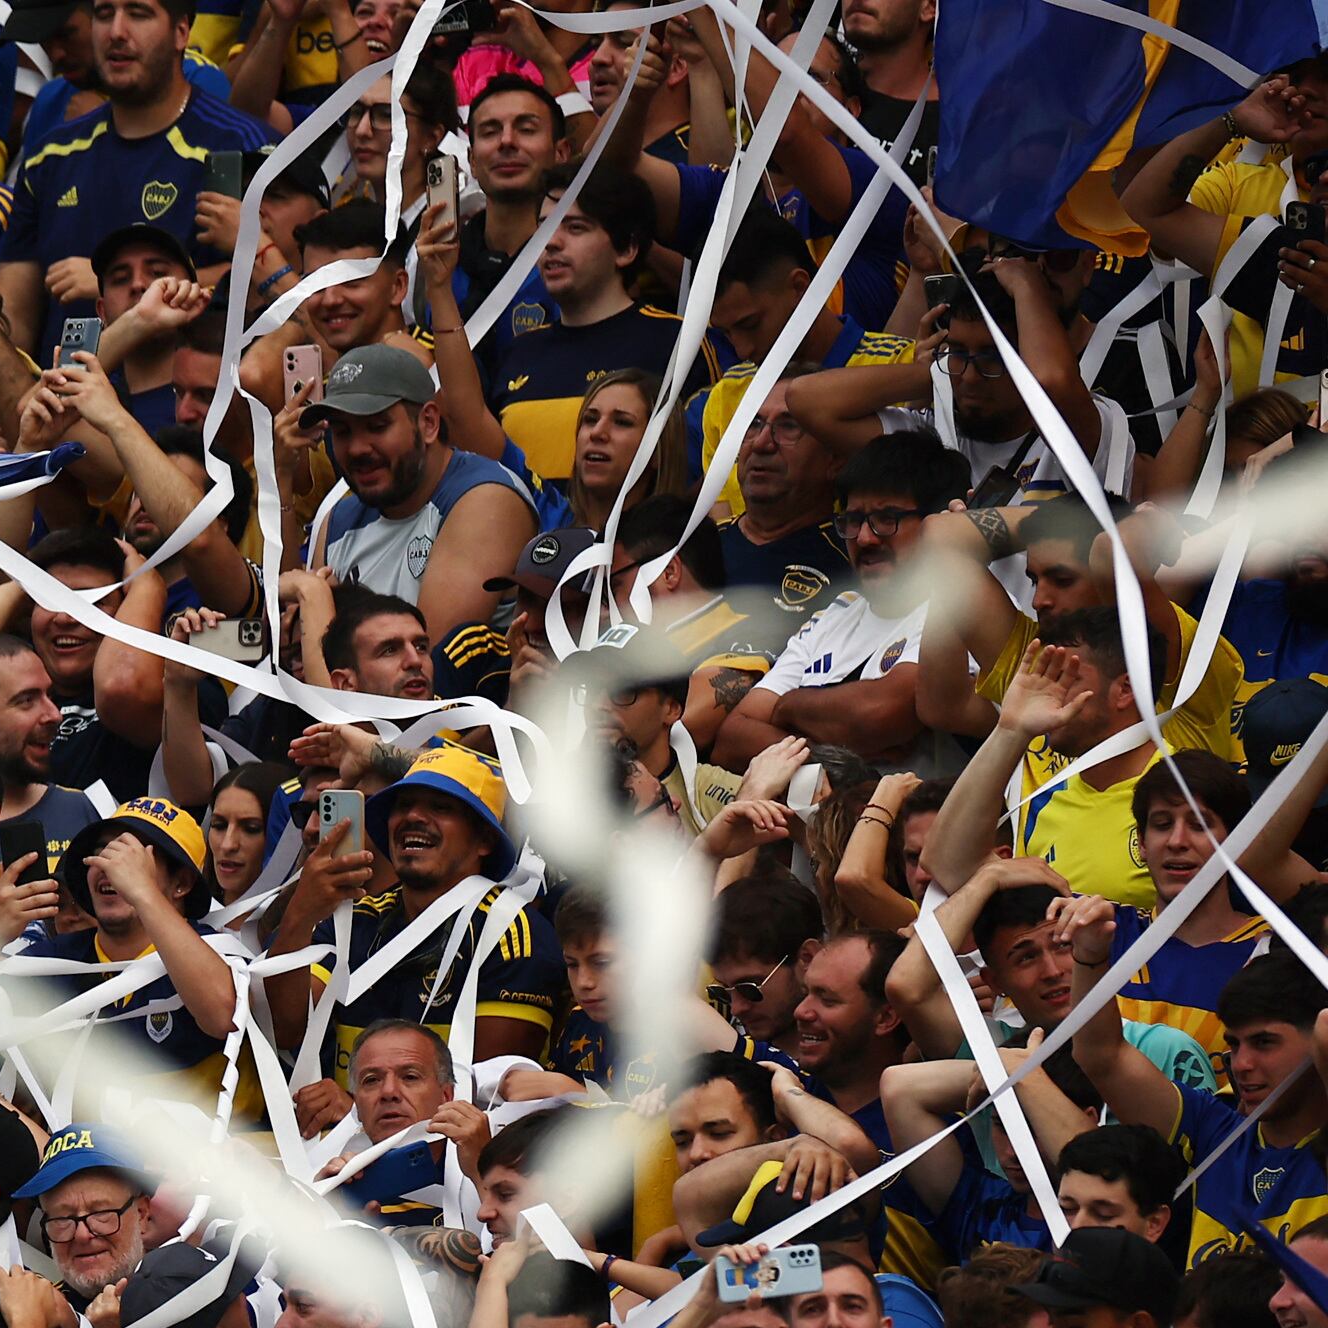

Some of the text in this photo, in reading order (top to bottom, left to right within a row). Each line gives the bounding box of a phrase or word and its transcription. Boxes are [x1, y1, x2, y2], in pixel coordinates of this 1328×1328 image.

[785, 580, 816, 597] CABJ
[1274, 743, 1302, 757] NIKE
[705, 783, 737, 806] unic
[127, 798, 176, 822] CABJ
